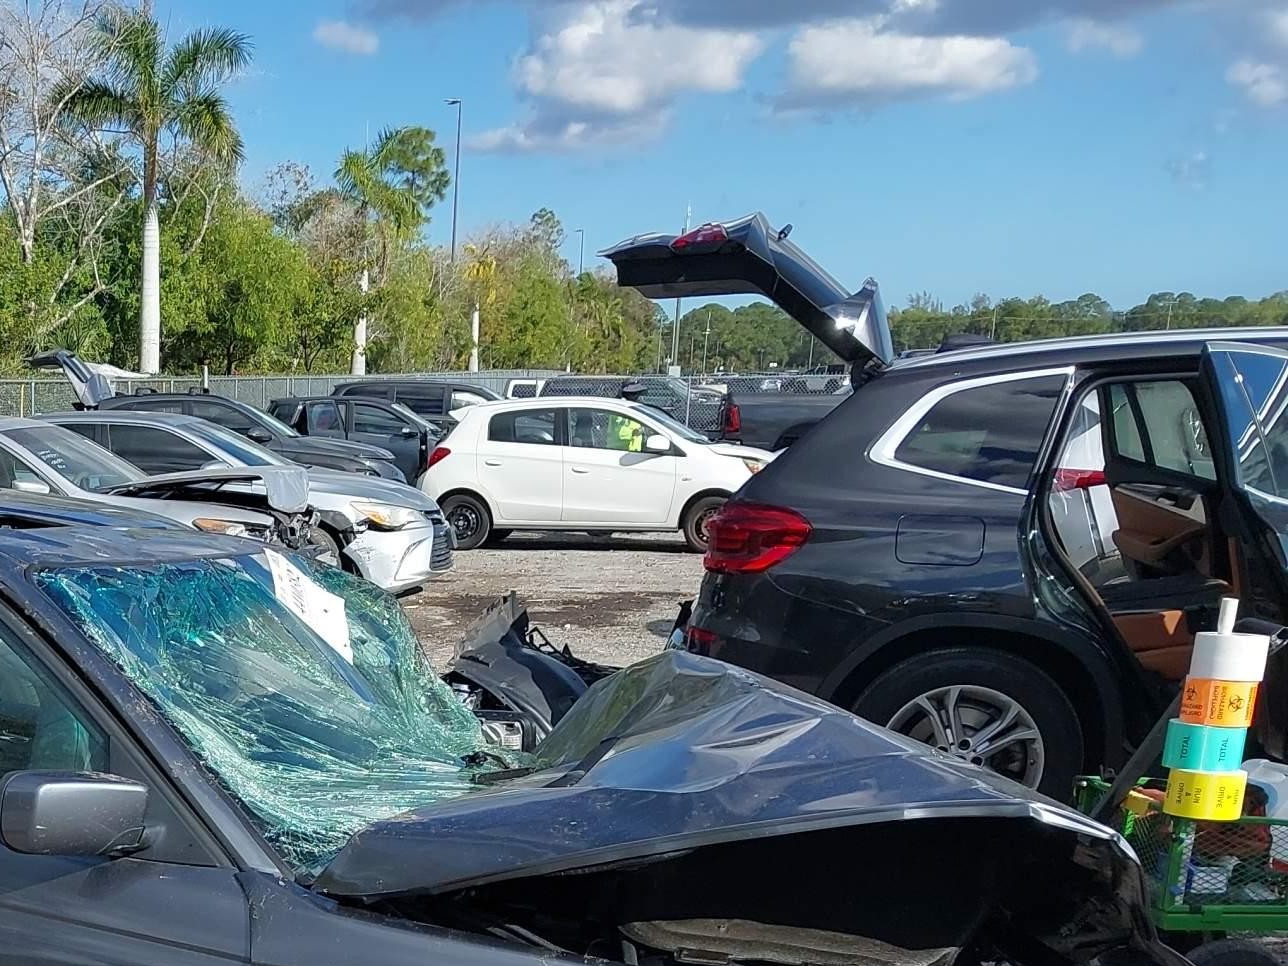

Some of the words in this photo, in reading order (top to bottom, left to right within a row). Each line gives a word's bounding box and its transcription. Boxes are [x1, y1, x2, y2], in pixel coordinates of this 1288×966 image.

[1180, 735, 1191, 760] TOTAL
[1218, 737, 1229, 762] TOTAL
[1176, 782, 1185, 804] DRIVE
[1193, 787, 1202, 804] RUN
[1216, 786, 1226, 808] DRIVE
